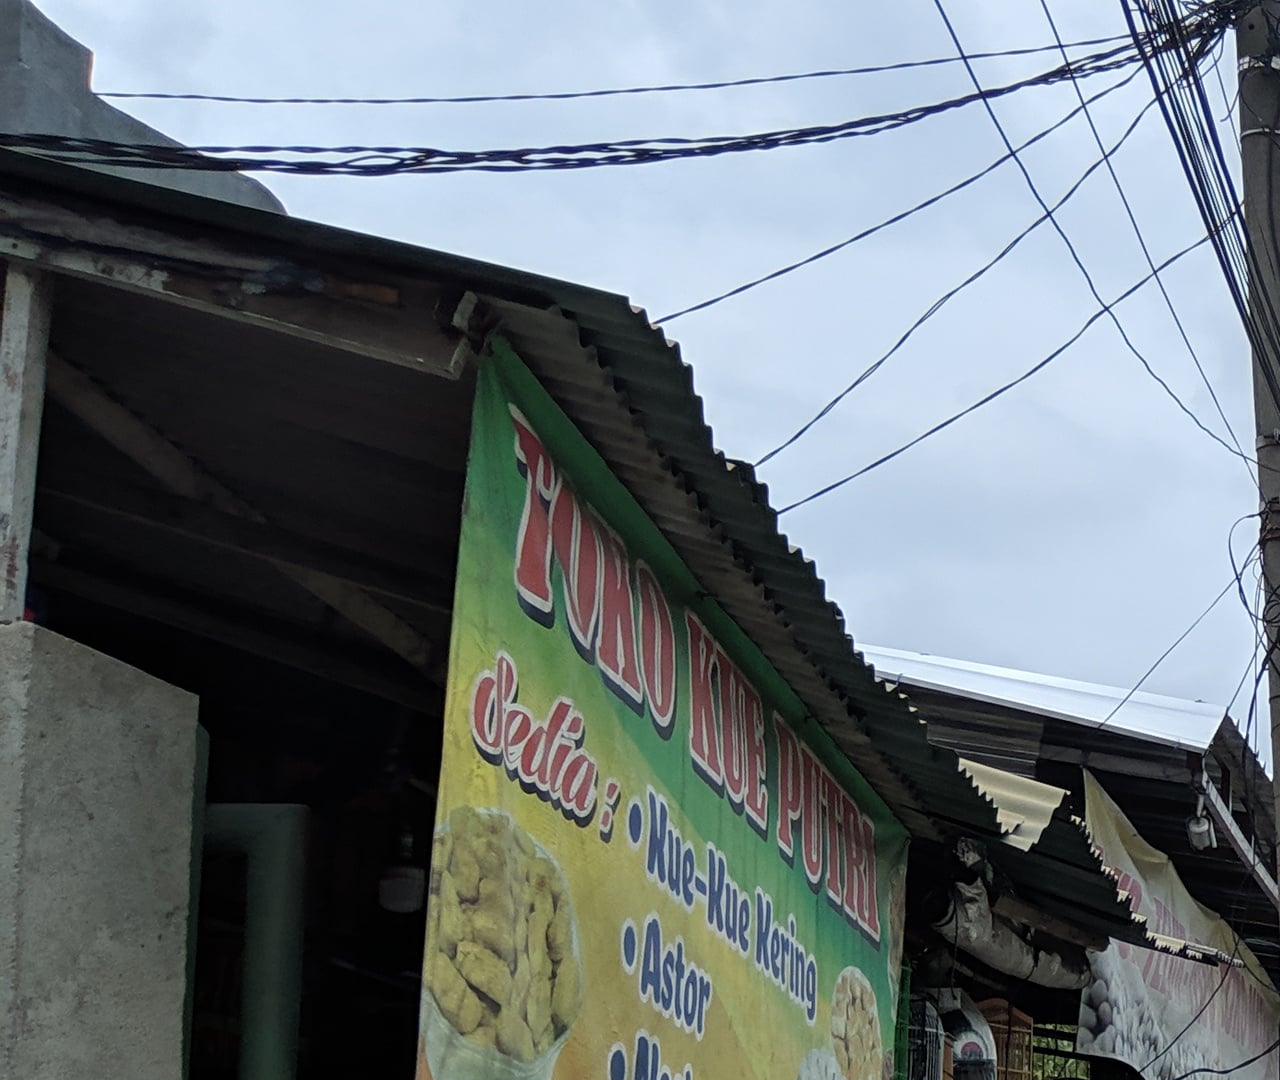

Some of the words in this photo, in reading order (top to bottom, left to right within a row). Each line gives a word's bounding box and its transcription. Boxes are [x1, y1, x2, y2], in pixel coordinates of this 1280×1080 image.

[508, 402, 677, 738] TOKO
[685, 607, 770, 838] KUE
[773, 710, 881, 946] PUTRI
[641, 915, 711, 1040] Astor
[647, 787, 752, 956] Kue-Kue
[755, 887, 818, 1025] Kering
